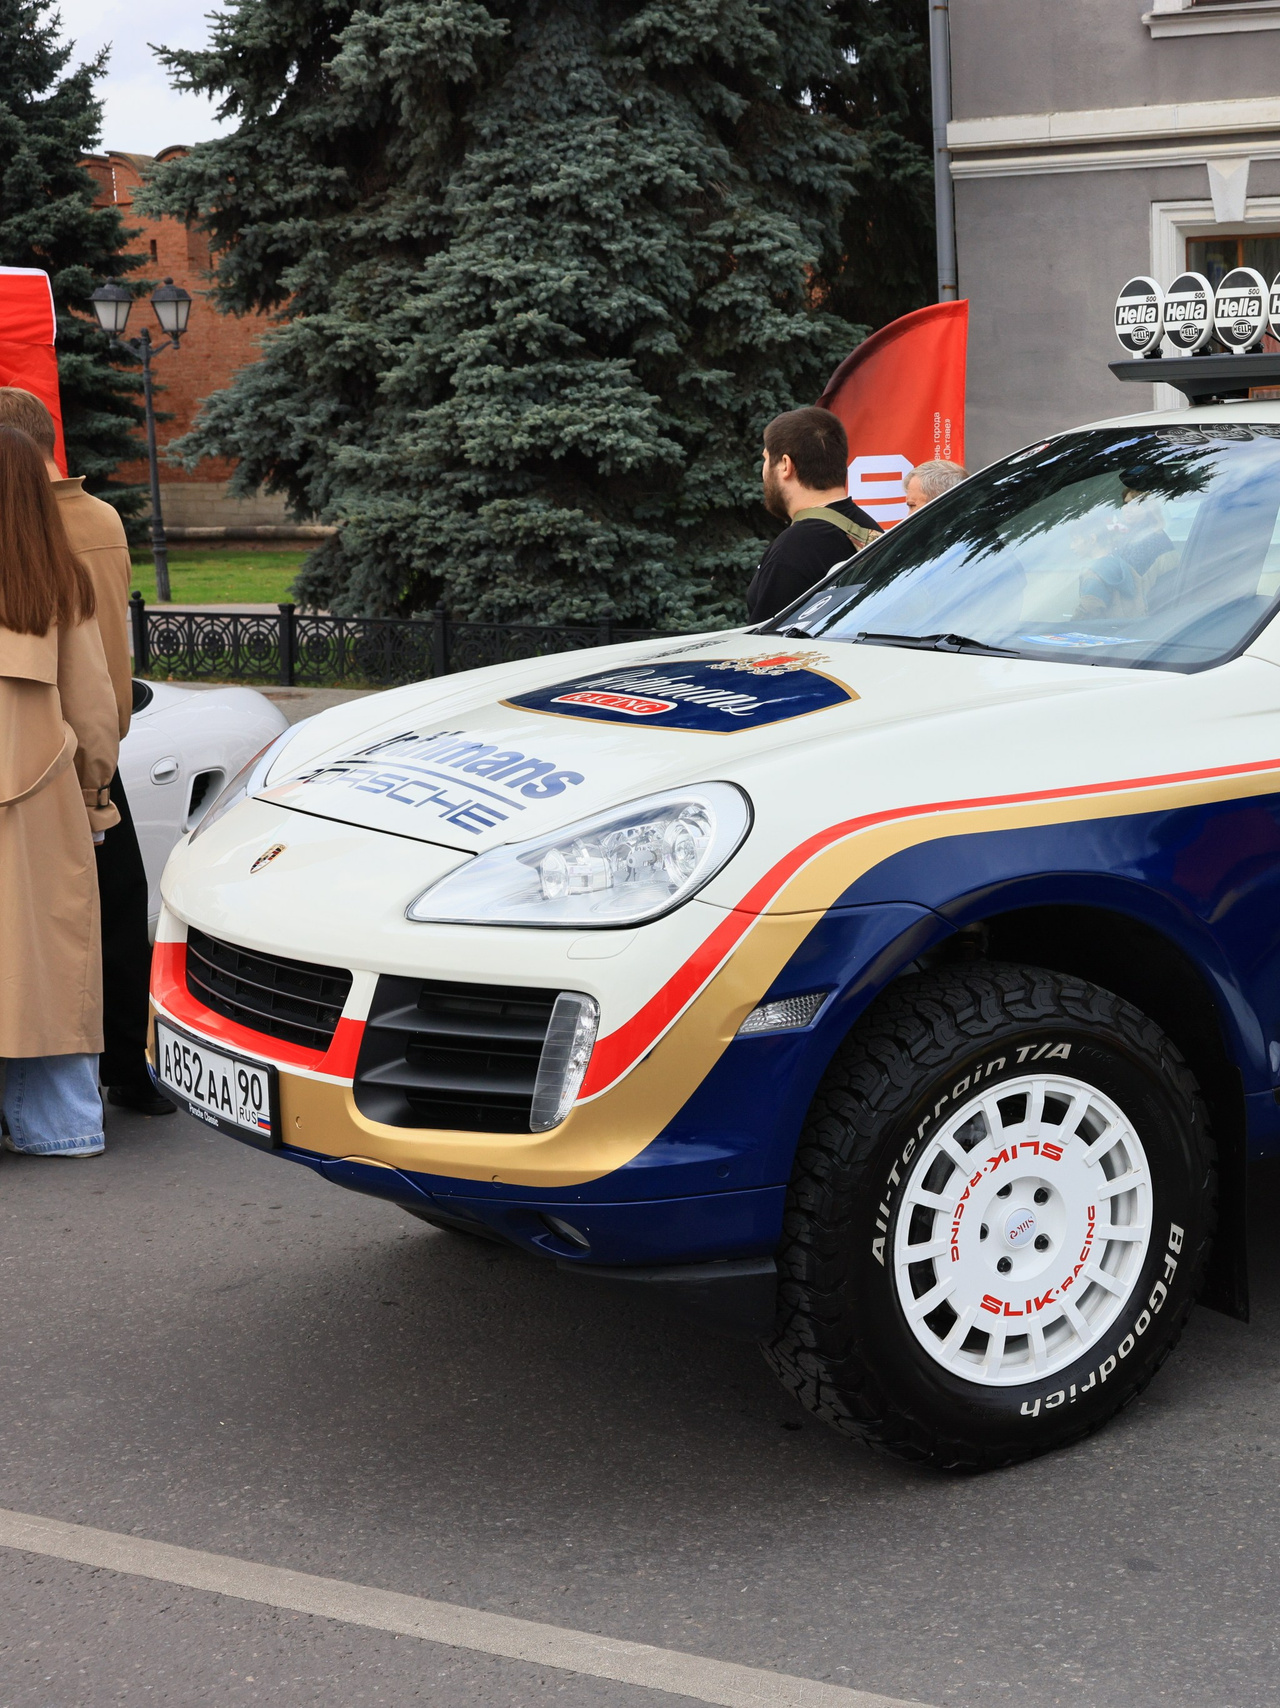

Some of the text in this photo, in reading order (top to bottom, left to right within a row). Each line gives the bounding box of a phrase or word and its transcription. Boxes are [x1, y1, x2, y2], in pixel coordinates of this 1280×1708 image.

[1145, 295, 1157, 303] 500
[1216, 297, 1260, 317] Hella
[1117, 304, 1157, 325] Hella
[1165, 301, 1206, 322] Hella
[1132, 330, 1150, 339] HELLA
[1181, 327, 1199, 336] HELLA
[1233, 324, 1252, 333] HELLA
[934, 412, 942, 460] ень города
[566, 692, 660, 713] RACING
[238, 1069, 262, 1111] 90
[240, 1107, 257, 1125] RUS
[872, 1043, 1072, 1267] All-Terrain T/A
[1020, 1222, 1184, 1417] BFGoodrich
